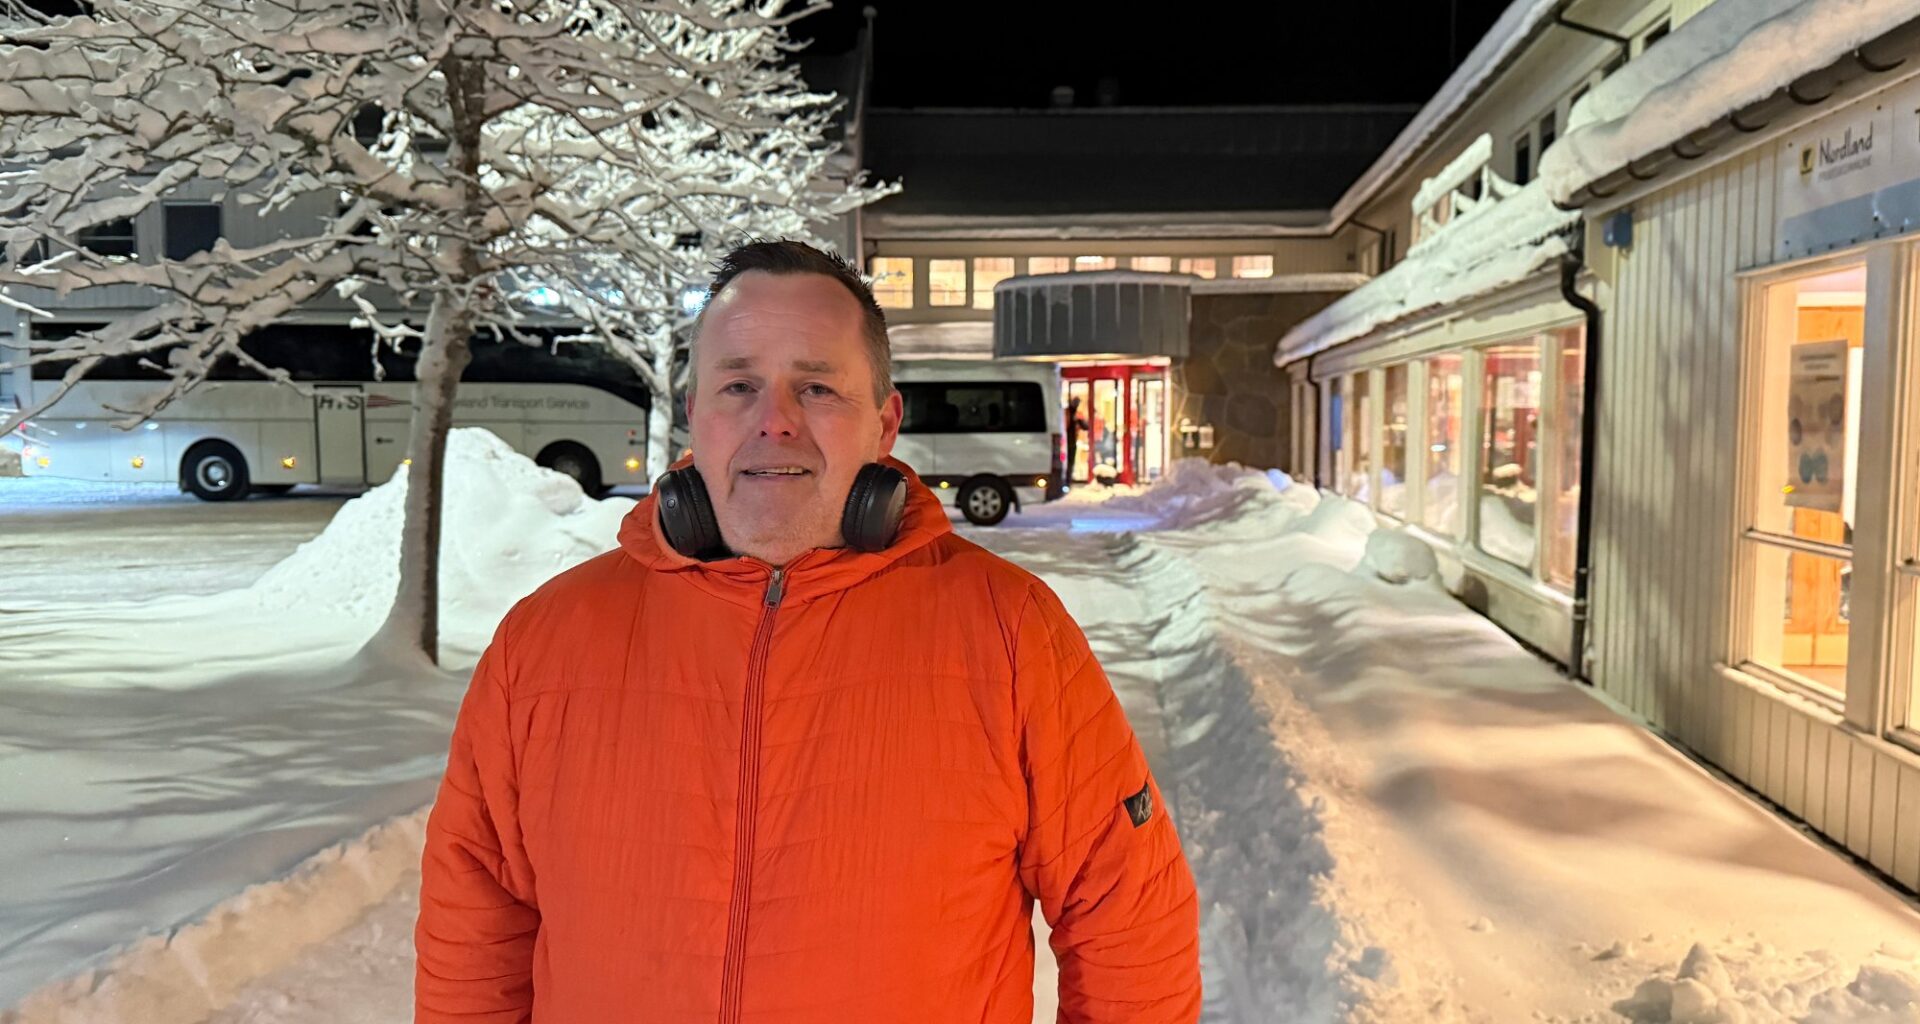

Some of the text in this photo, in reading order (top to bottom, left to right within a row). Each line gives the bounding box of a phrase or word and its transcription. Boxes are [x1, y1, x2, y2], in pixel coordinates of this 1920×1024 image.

[1819, 120, 1873, 167] Nordland
[491, 395, 544, 411] Transport
[546, 396, 591, 410] Service
